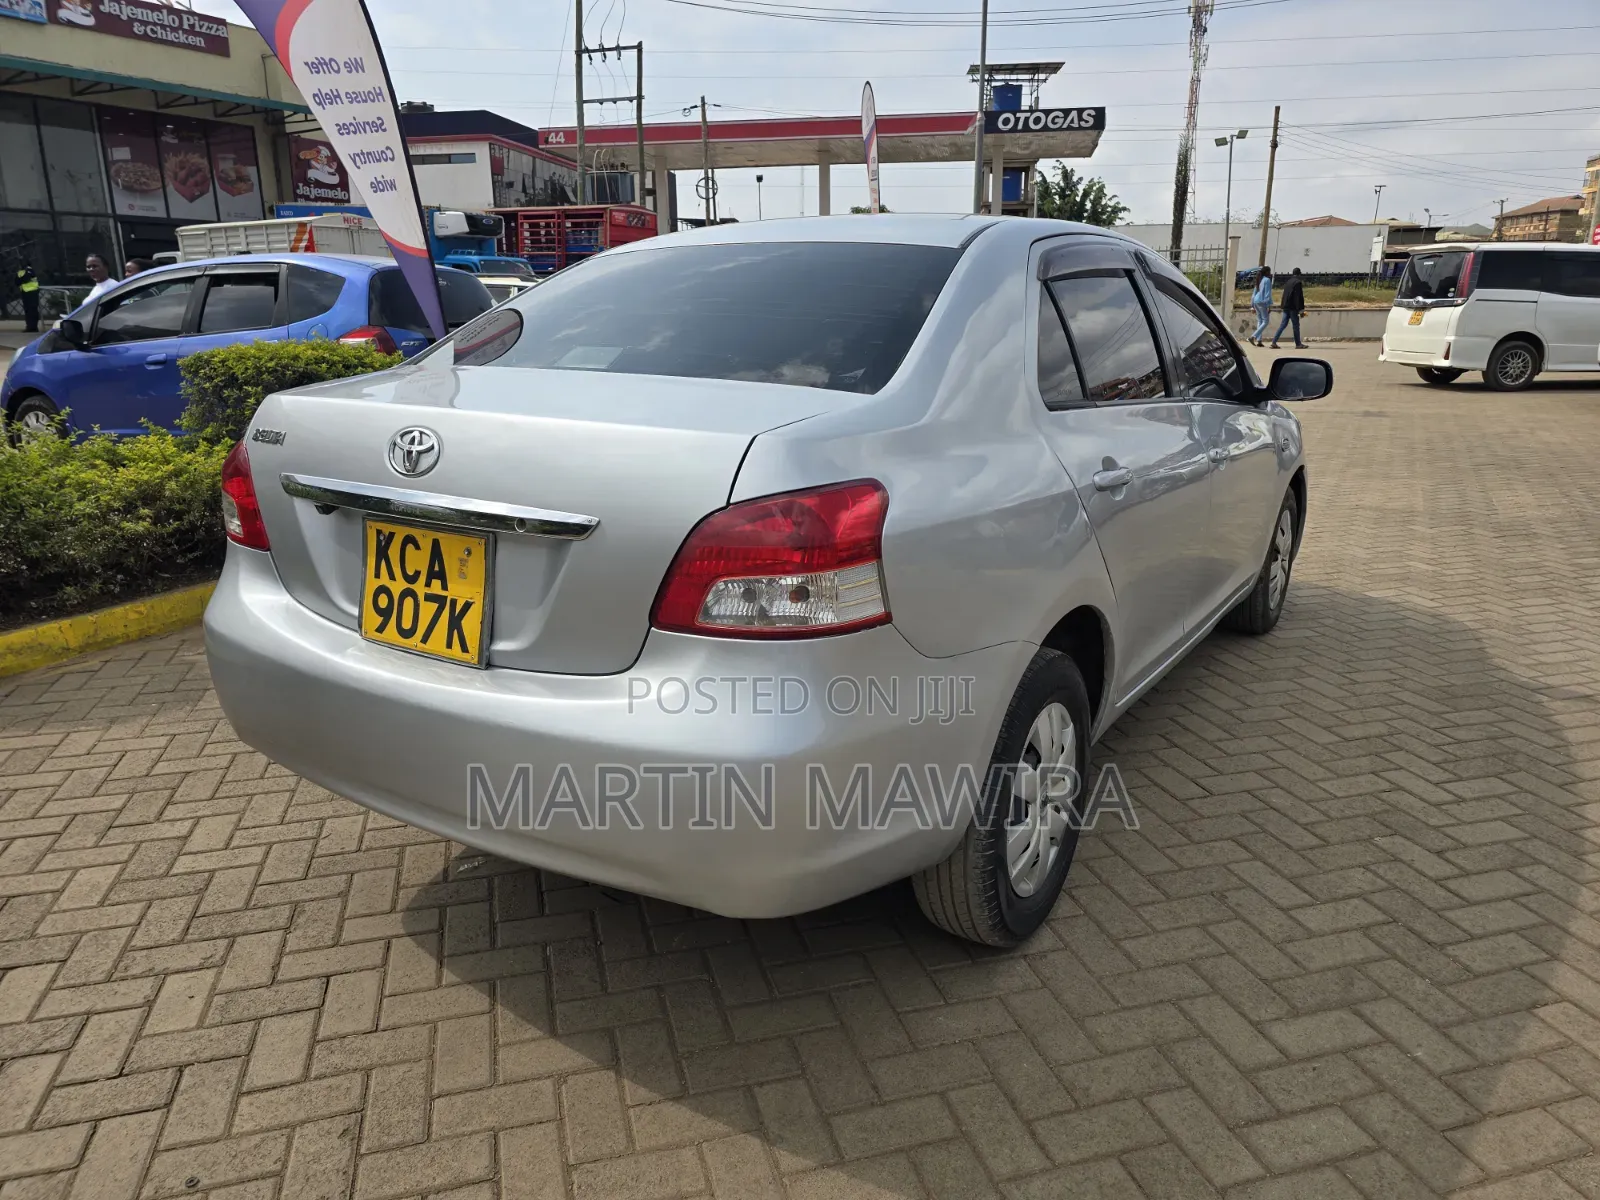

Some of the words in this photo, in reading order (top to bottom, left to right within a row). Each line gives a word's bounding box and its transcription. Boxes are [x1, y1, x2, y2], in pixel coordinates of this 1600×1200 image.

[99, 0, 180, 28] Jajemelo
[180, 13, 229, 38] Pizza
[146, 25, 206, 47] Chicken
[997, 109, 1096, 131] OTOGAS
[548, 131, 566, 144] 44
[296, 183, 349, 200] Jajemelo
[343, 216, 363, 226] NICE
[374, 528, 449, 592] KCA
[372, 584, 475, 654] 907K
